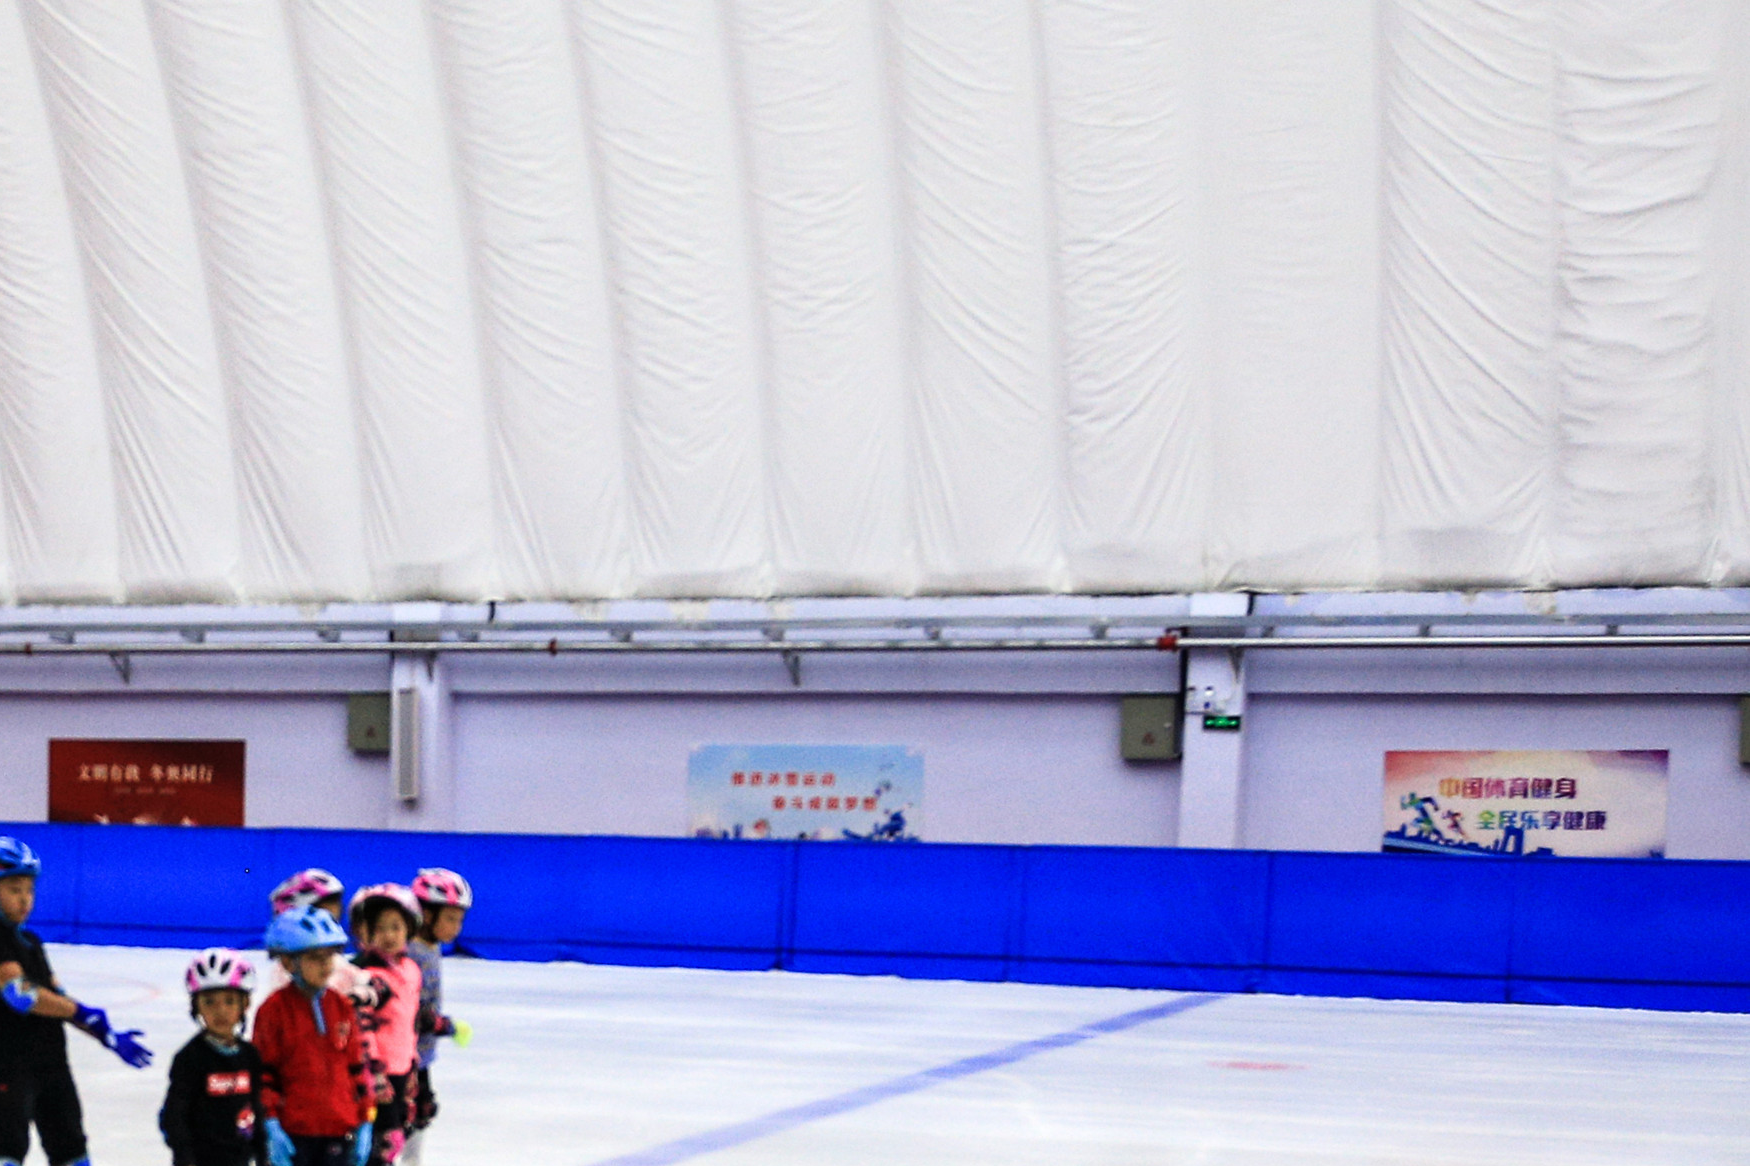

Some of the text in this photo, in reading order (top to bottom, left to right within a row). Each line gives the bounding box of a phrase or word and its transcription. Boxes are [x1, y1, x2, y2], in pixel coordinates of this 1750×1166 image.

[1439, 777, 1577, 799] 中国体育健身
[1476, 810, 1607, 830] 全民乐享健康
